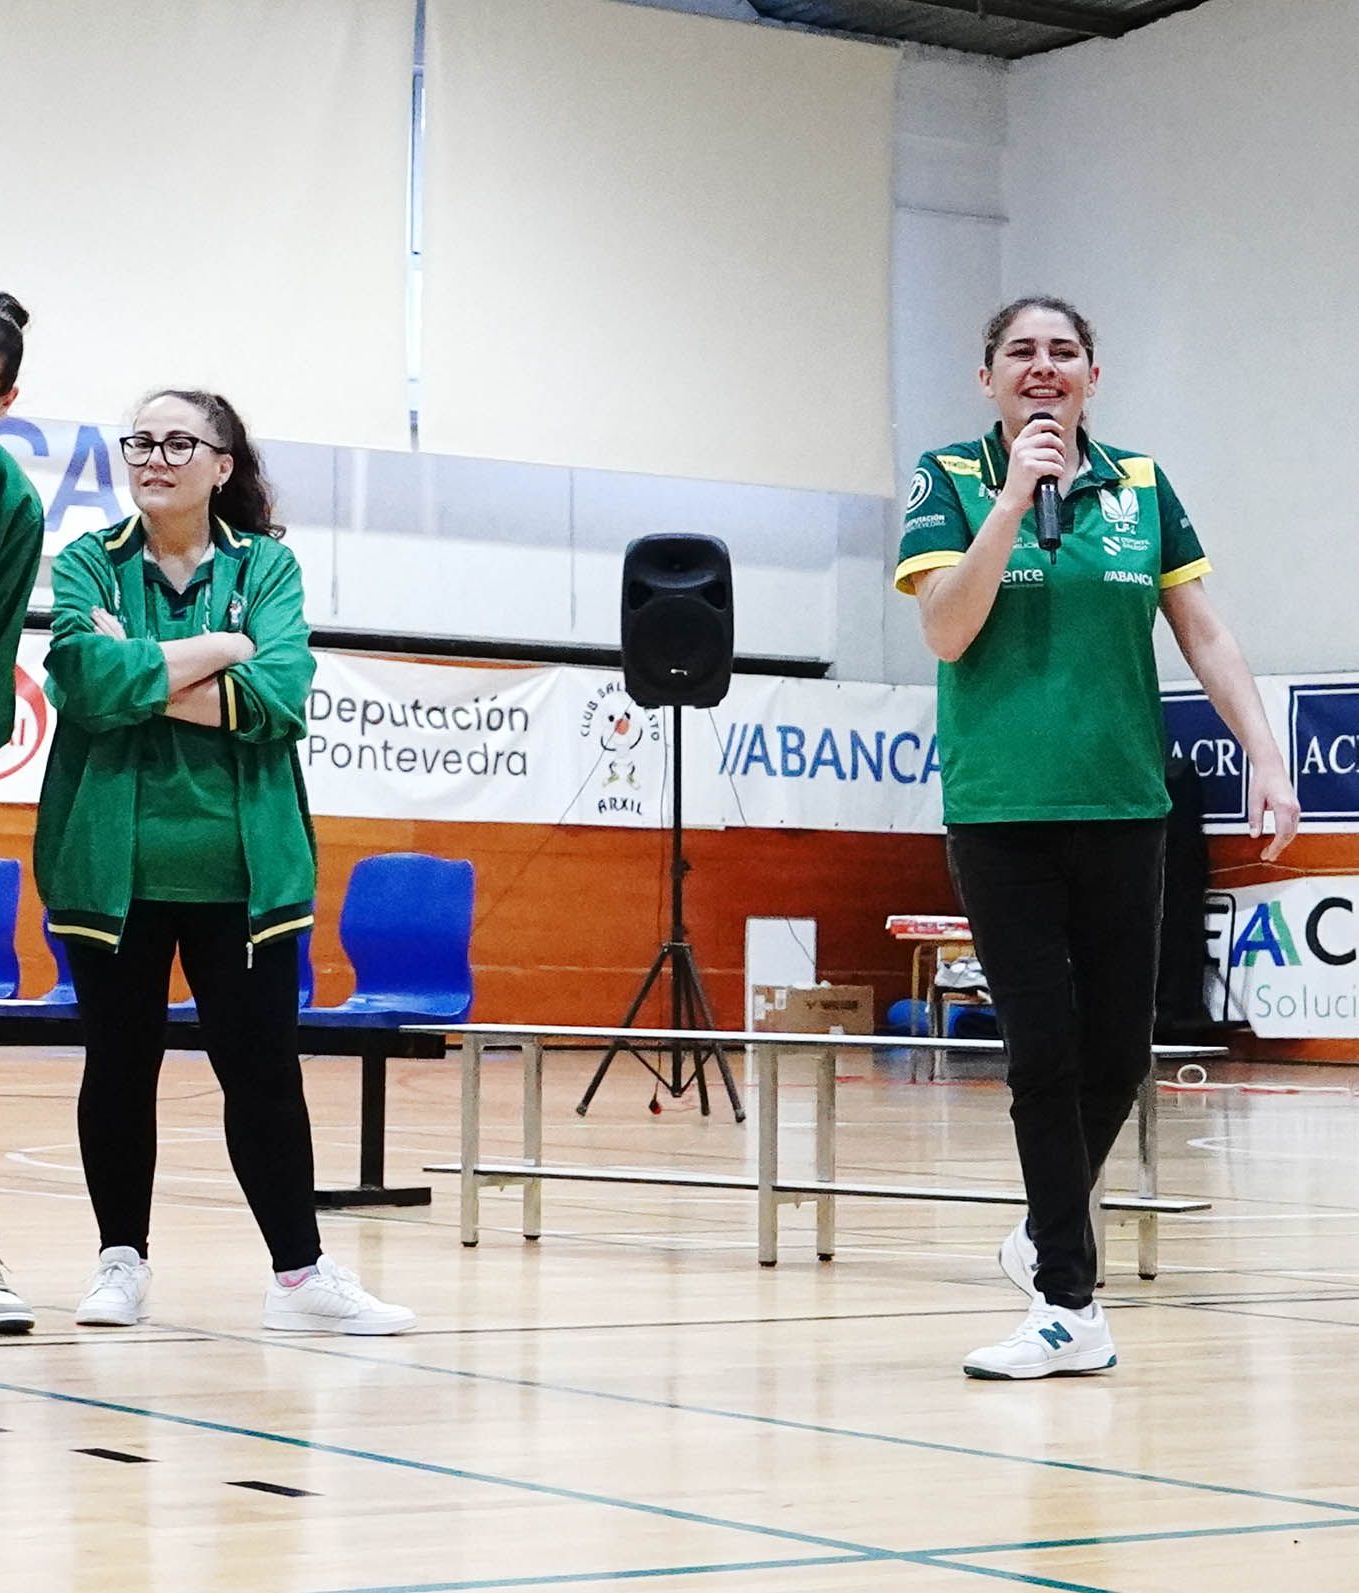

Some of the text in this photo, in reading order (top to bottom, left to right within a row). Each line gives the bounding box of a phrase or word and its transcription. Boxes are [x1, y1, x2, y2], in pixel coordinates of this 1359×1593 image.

[309, 688, 531, 737] Deputación
[307, 734, 528, 776] Pontevedra
[1300, 733, 1359, 775] AC
[597, 797, 643, 816] ARXIL
